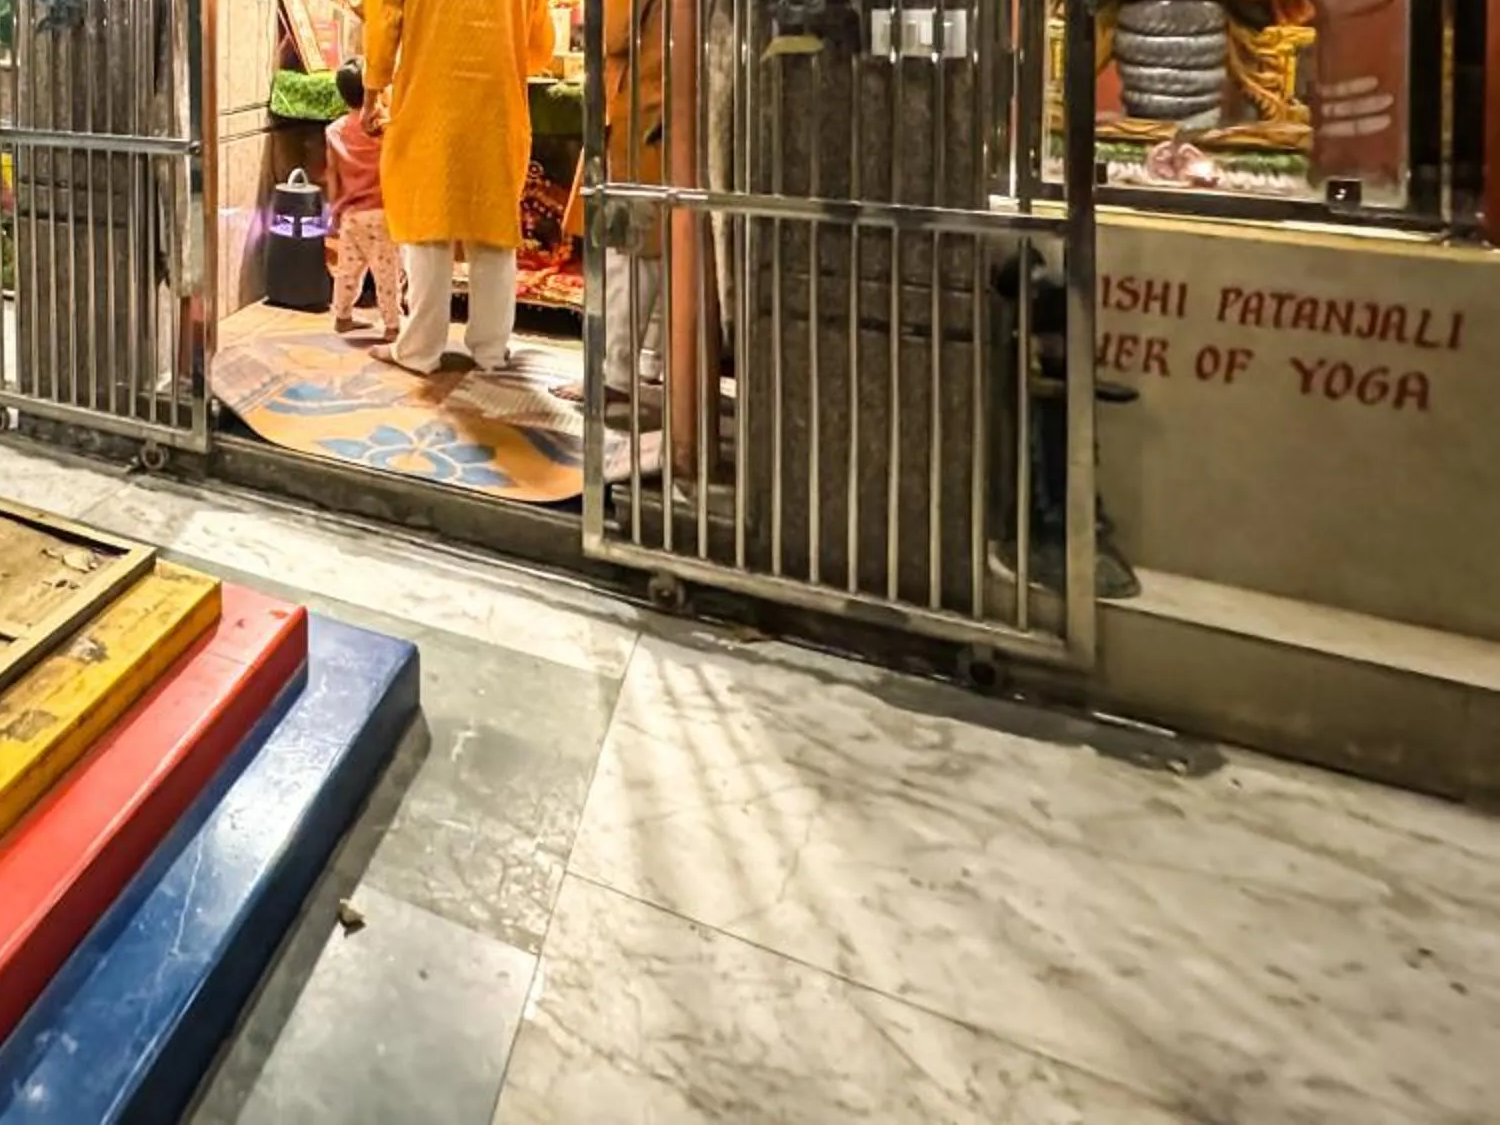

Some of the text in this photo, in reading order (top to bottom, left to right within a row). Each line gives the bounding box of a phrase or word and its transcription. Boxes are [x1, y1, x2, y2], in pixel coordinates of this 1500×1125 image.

[1101, 274, 1465, 352] ISHI PATANJALI
[1194, 345, 1255, 385] OF
[1289, 356, 1431, 412] YOGA
